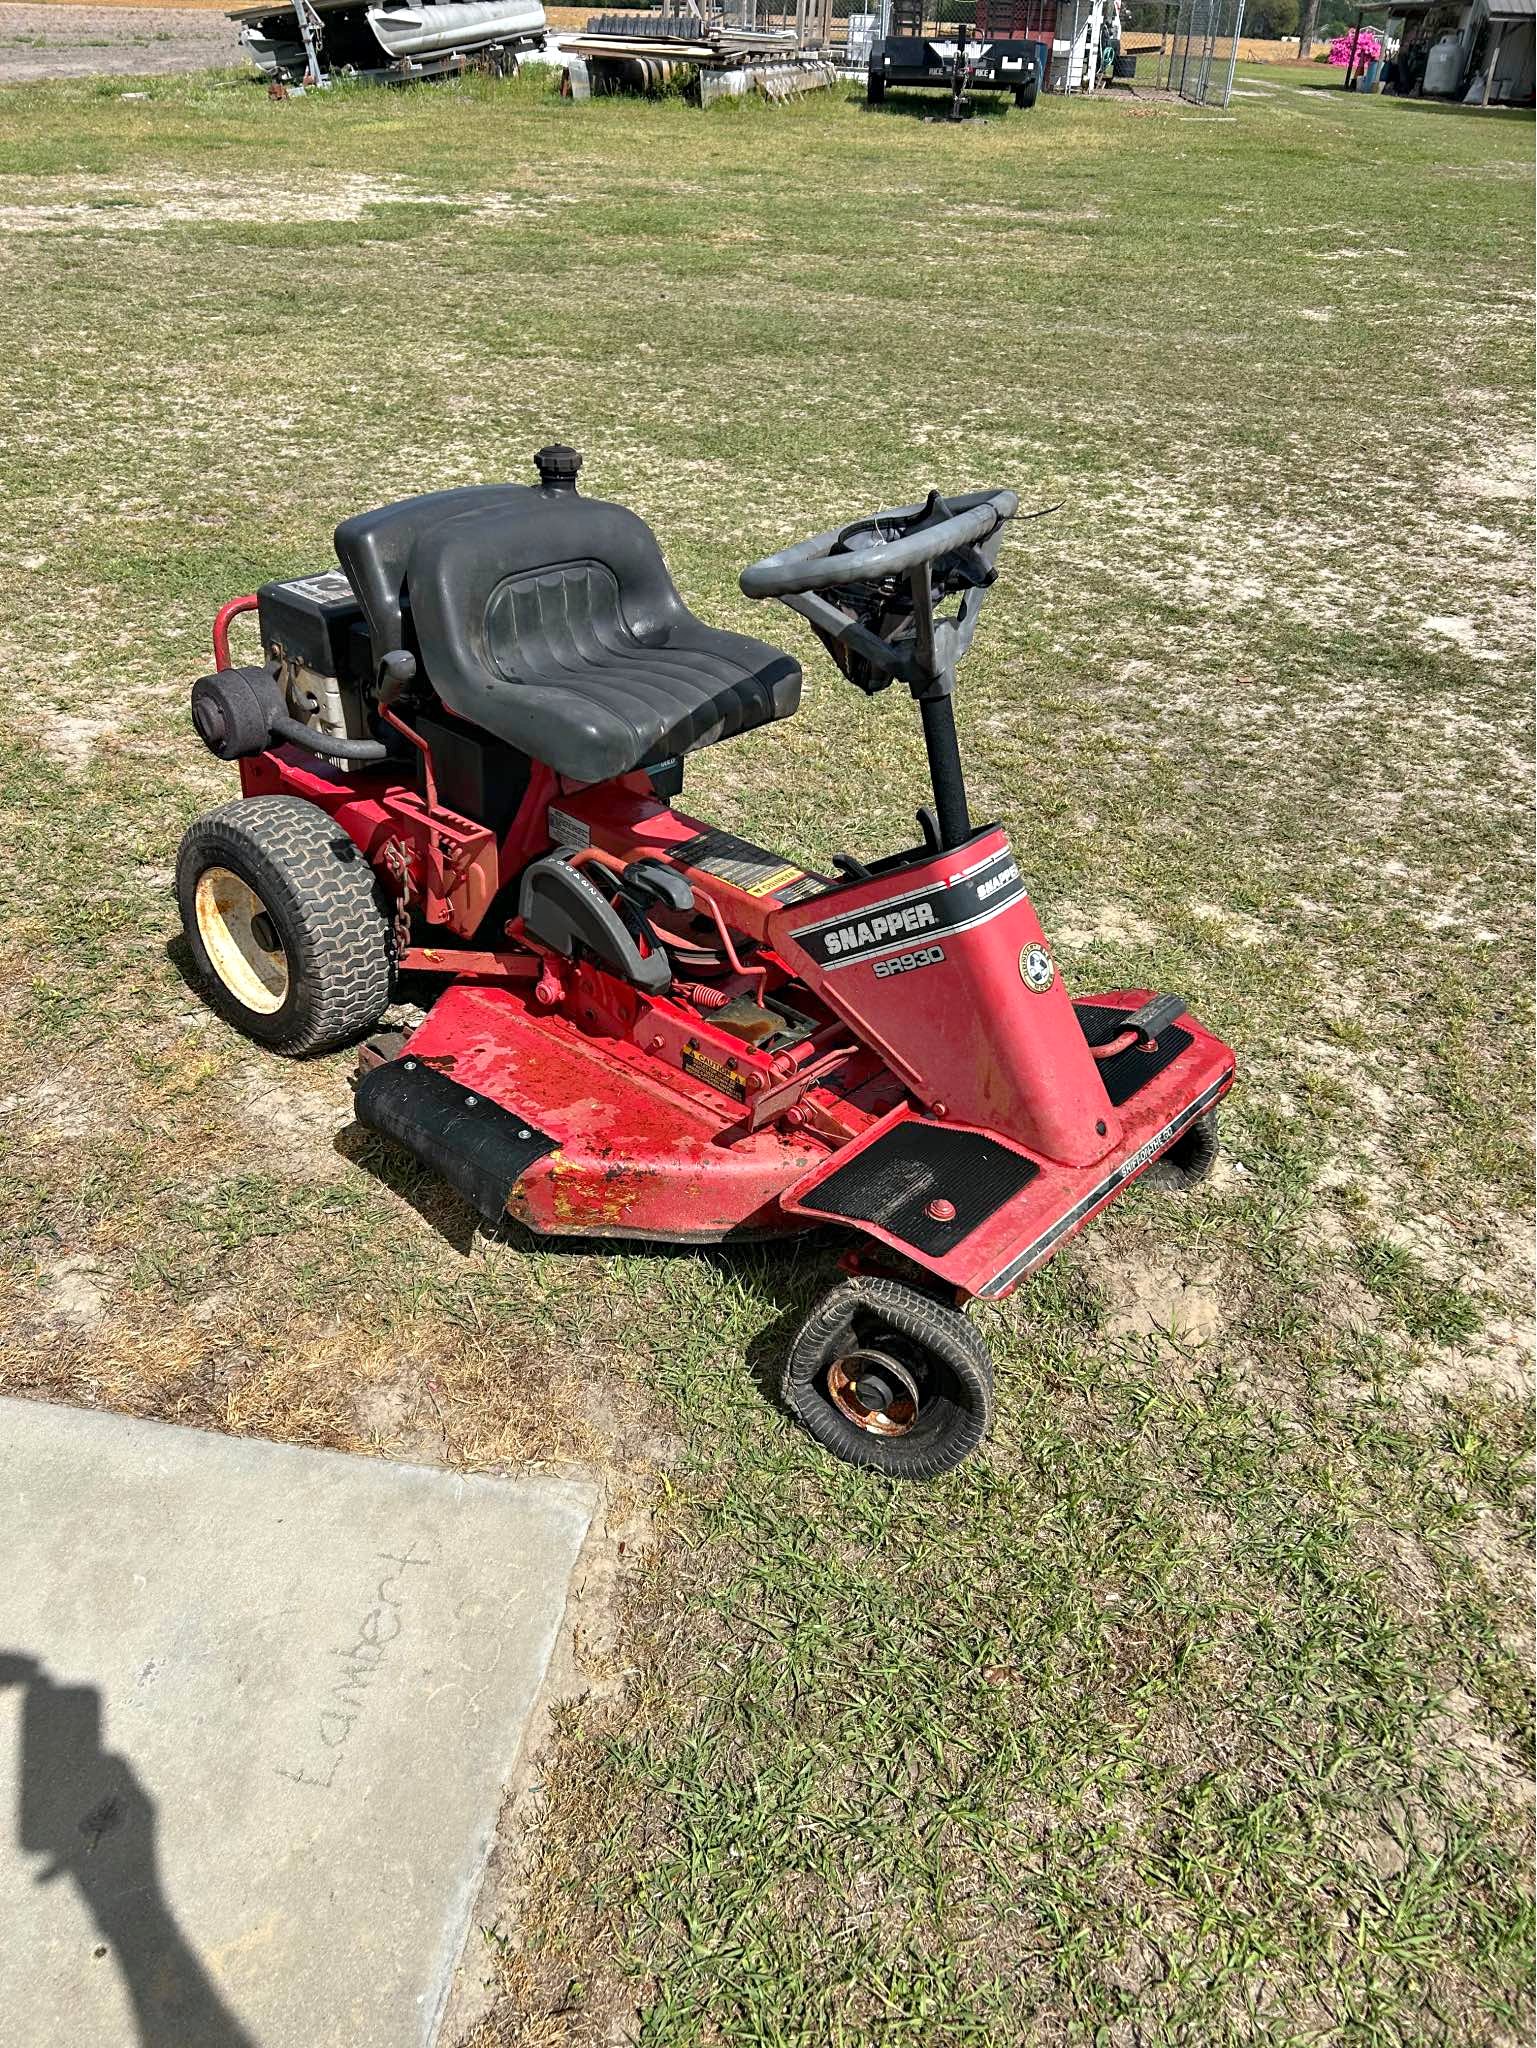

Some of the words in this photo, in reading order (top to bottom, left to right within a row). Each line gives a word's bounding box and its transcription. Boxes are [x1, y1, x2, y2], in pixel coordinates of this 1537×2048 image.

[928, 67, 944, 76] RICE
[975, 68, 989, 77] RICE
[588, 887, 597, 895] 2
[976, 863, 1020, 899] SNAPPE
[824, 902, 936, 955] SNAPPER
[873, 945, 945, 979] SR930
[698, 1054, 731, 1077] CAUTION
[272, 1541, 432, 1789] Lambert
